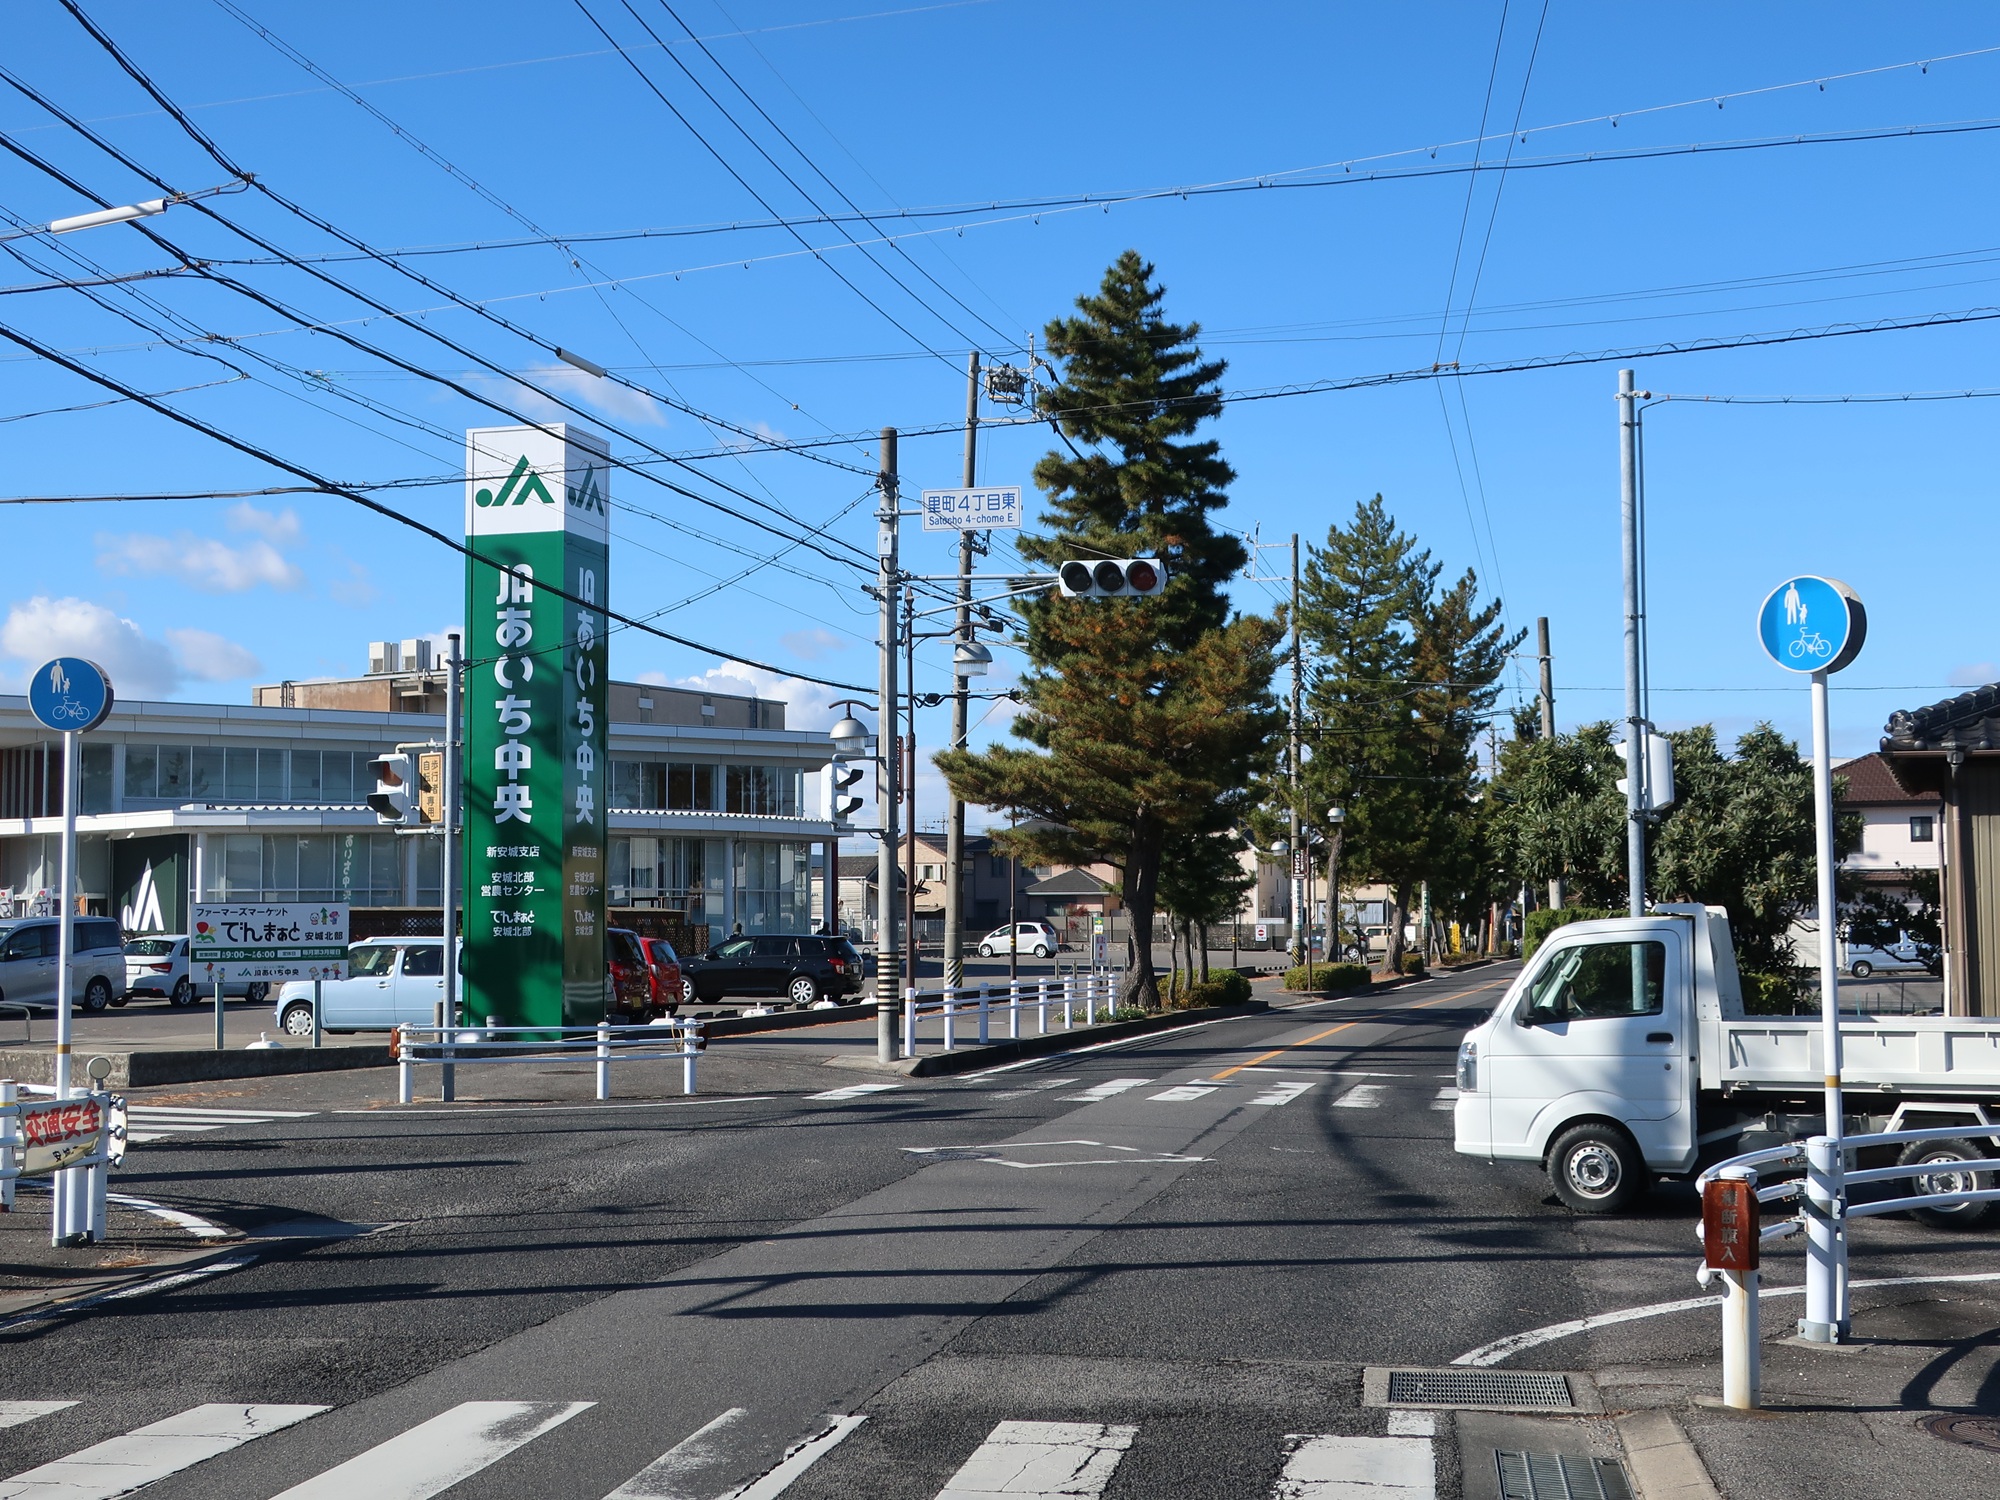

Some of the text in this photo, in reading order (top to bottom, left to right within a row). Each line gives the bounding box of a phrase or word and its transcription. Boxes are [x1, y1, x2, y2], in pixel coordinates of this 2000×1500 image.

[928, 492, 1016, 513] 里町4丁目東
[928, 515, 963, 526] Satocho
[965, 514, 1005, 524] 4-chome
[486, 845, 540, 858] 新安城支店
[572, 845, 597, 858] 新安城支店
[491, 871, 535, 883] 安城北部
[574, 872, 595, 883] 安城北部
[481, 884, 545, 897] 営農センター
[569, 884, 600, 896] 営農センター
[196, 907, 289, 917] ファーマーズマーケット
[489, 910, 535, 923] でんまぁと
[220, 921, 301, 943] でんまぁと
[304, 931, 343, 941] 安城北部
[493, 926, 532, 937] 安城北部
[575, 926, 594, 936] 安城北部
[26, 1099, 101, 1148] 交通安全
